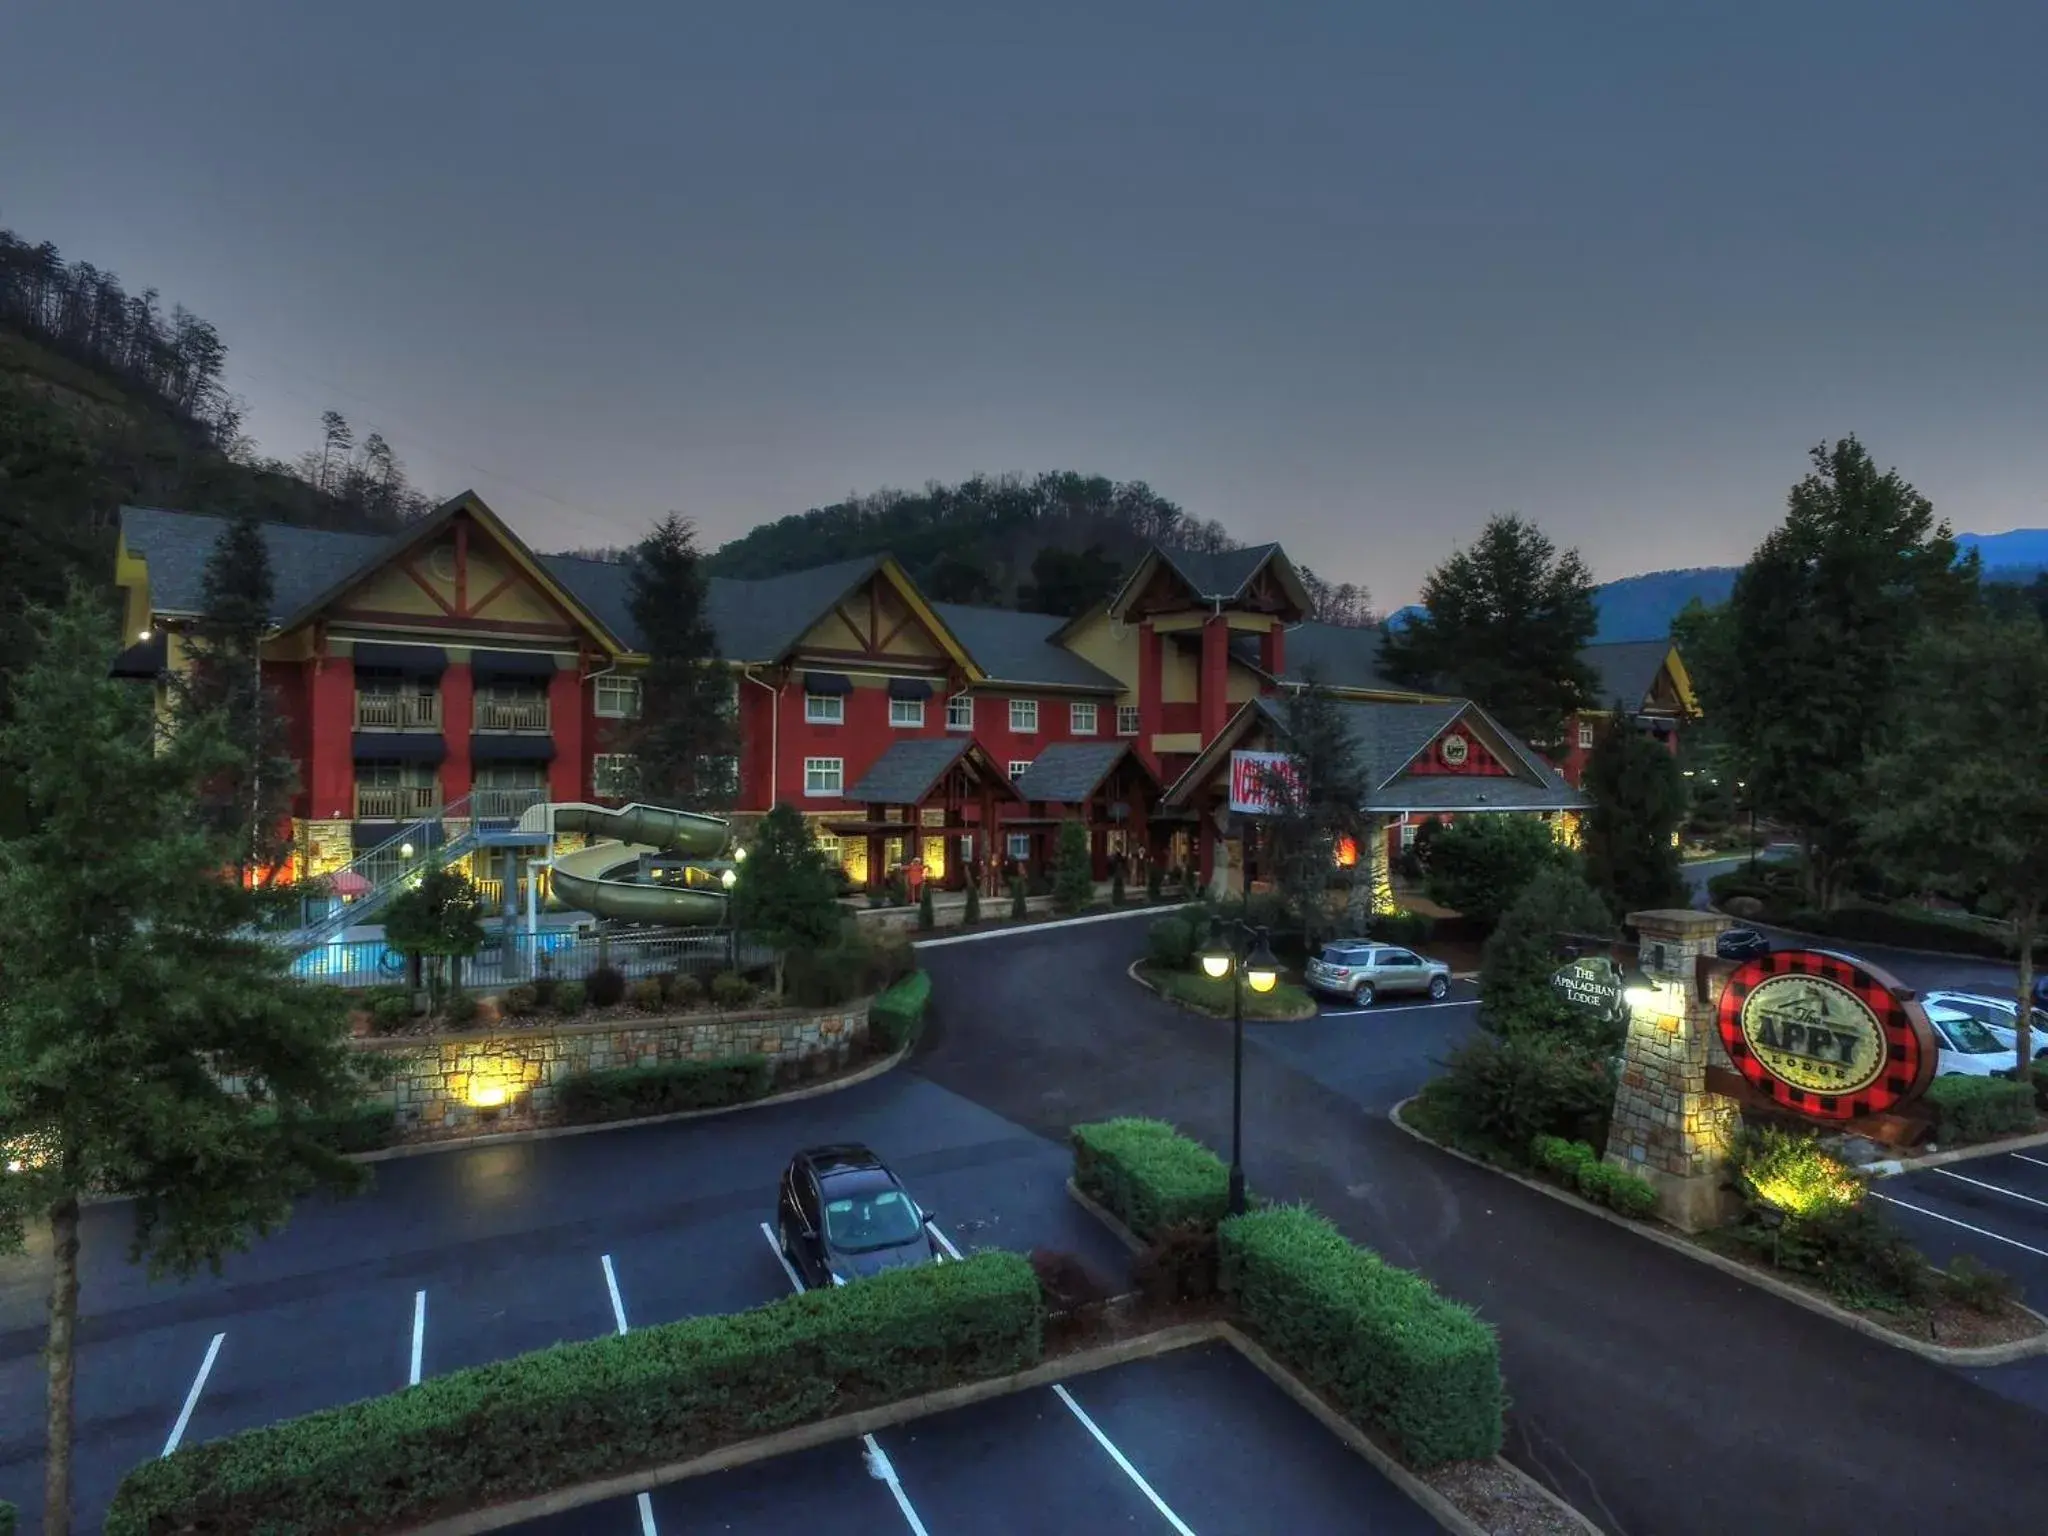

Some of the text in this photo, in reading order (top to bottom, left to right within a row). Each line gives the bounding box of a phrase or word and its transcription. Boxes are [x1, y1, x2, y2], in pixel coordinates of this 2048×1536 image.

[1574, 966, 1595, 981] THE
[1554, 974, 1615, 997] APPALACHIAN
[1567, 989, 1601, 1006] LODGE
[1793, 1007, 1822, 1025] The
[1755, 1015, 1860, 1065] APPY
[1770, 1055, 1846, 1079] LODGE
